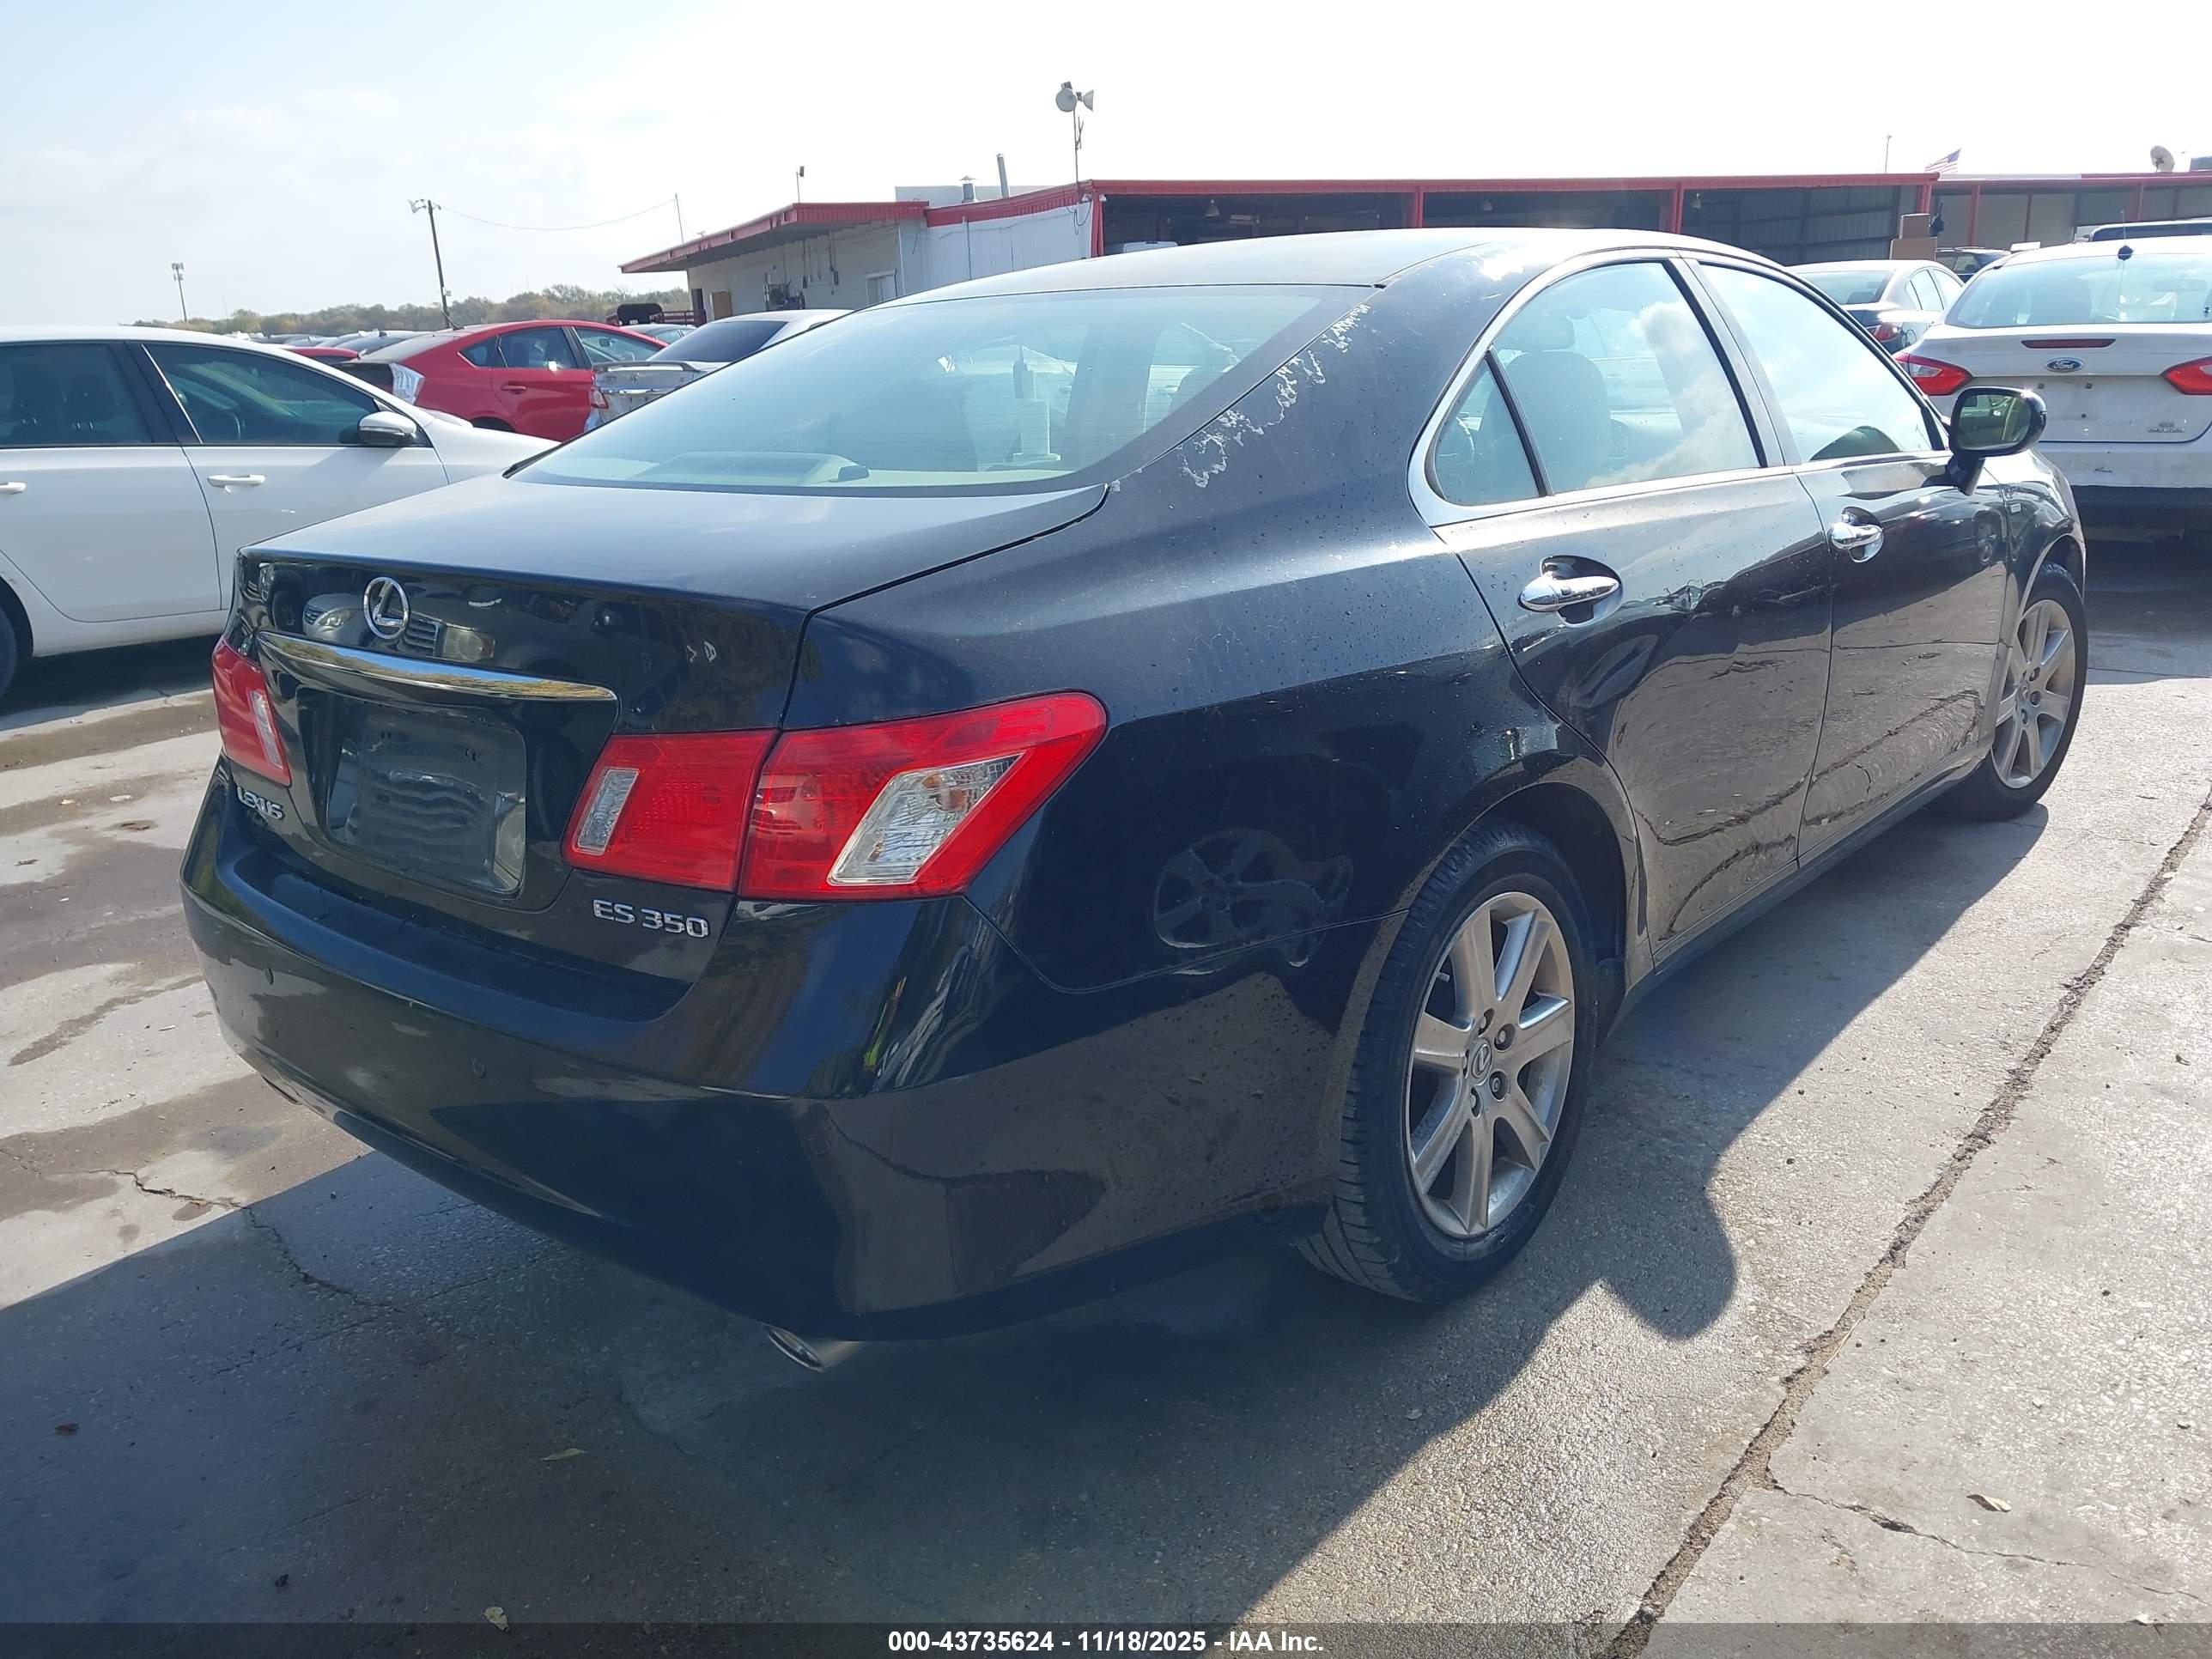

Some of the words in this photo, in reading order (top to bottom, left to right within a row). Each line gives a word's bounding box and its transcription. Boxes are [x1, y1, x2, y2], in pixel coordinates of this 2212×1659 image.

[237, 787, 283, 819] LEXUS
[593, 899, 635, 924] ES
[641, 908, 709, 938] 350
